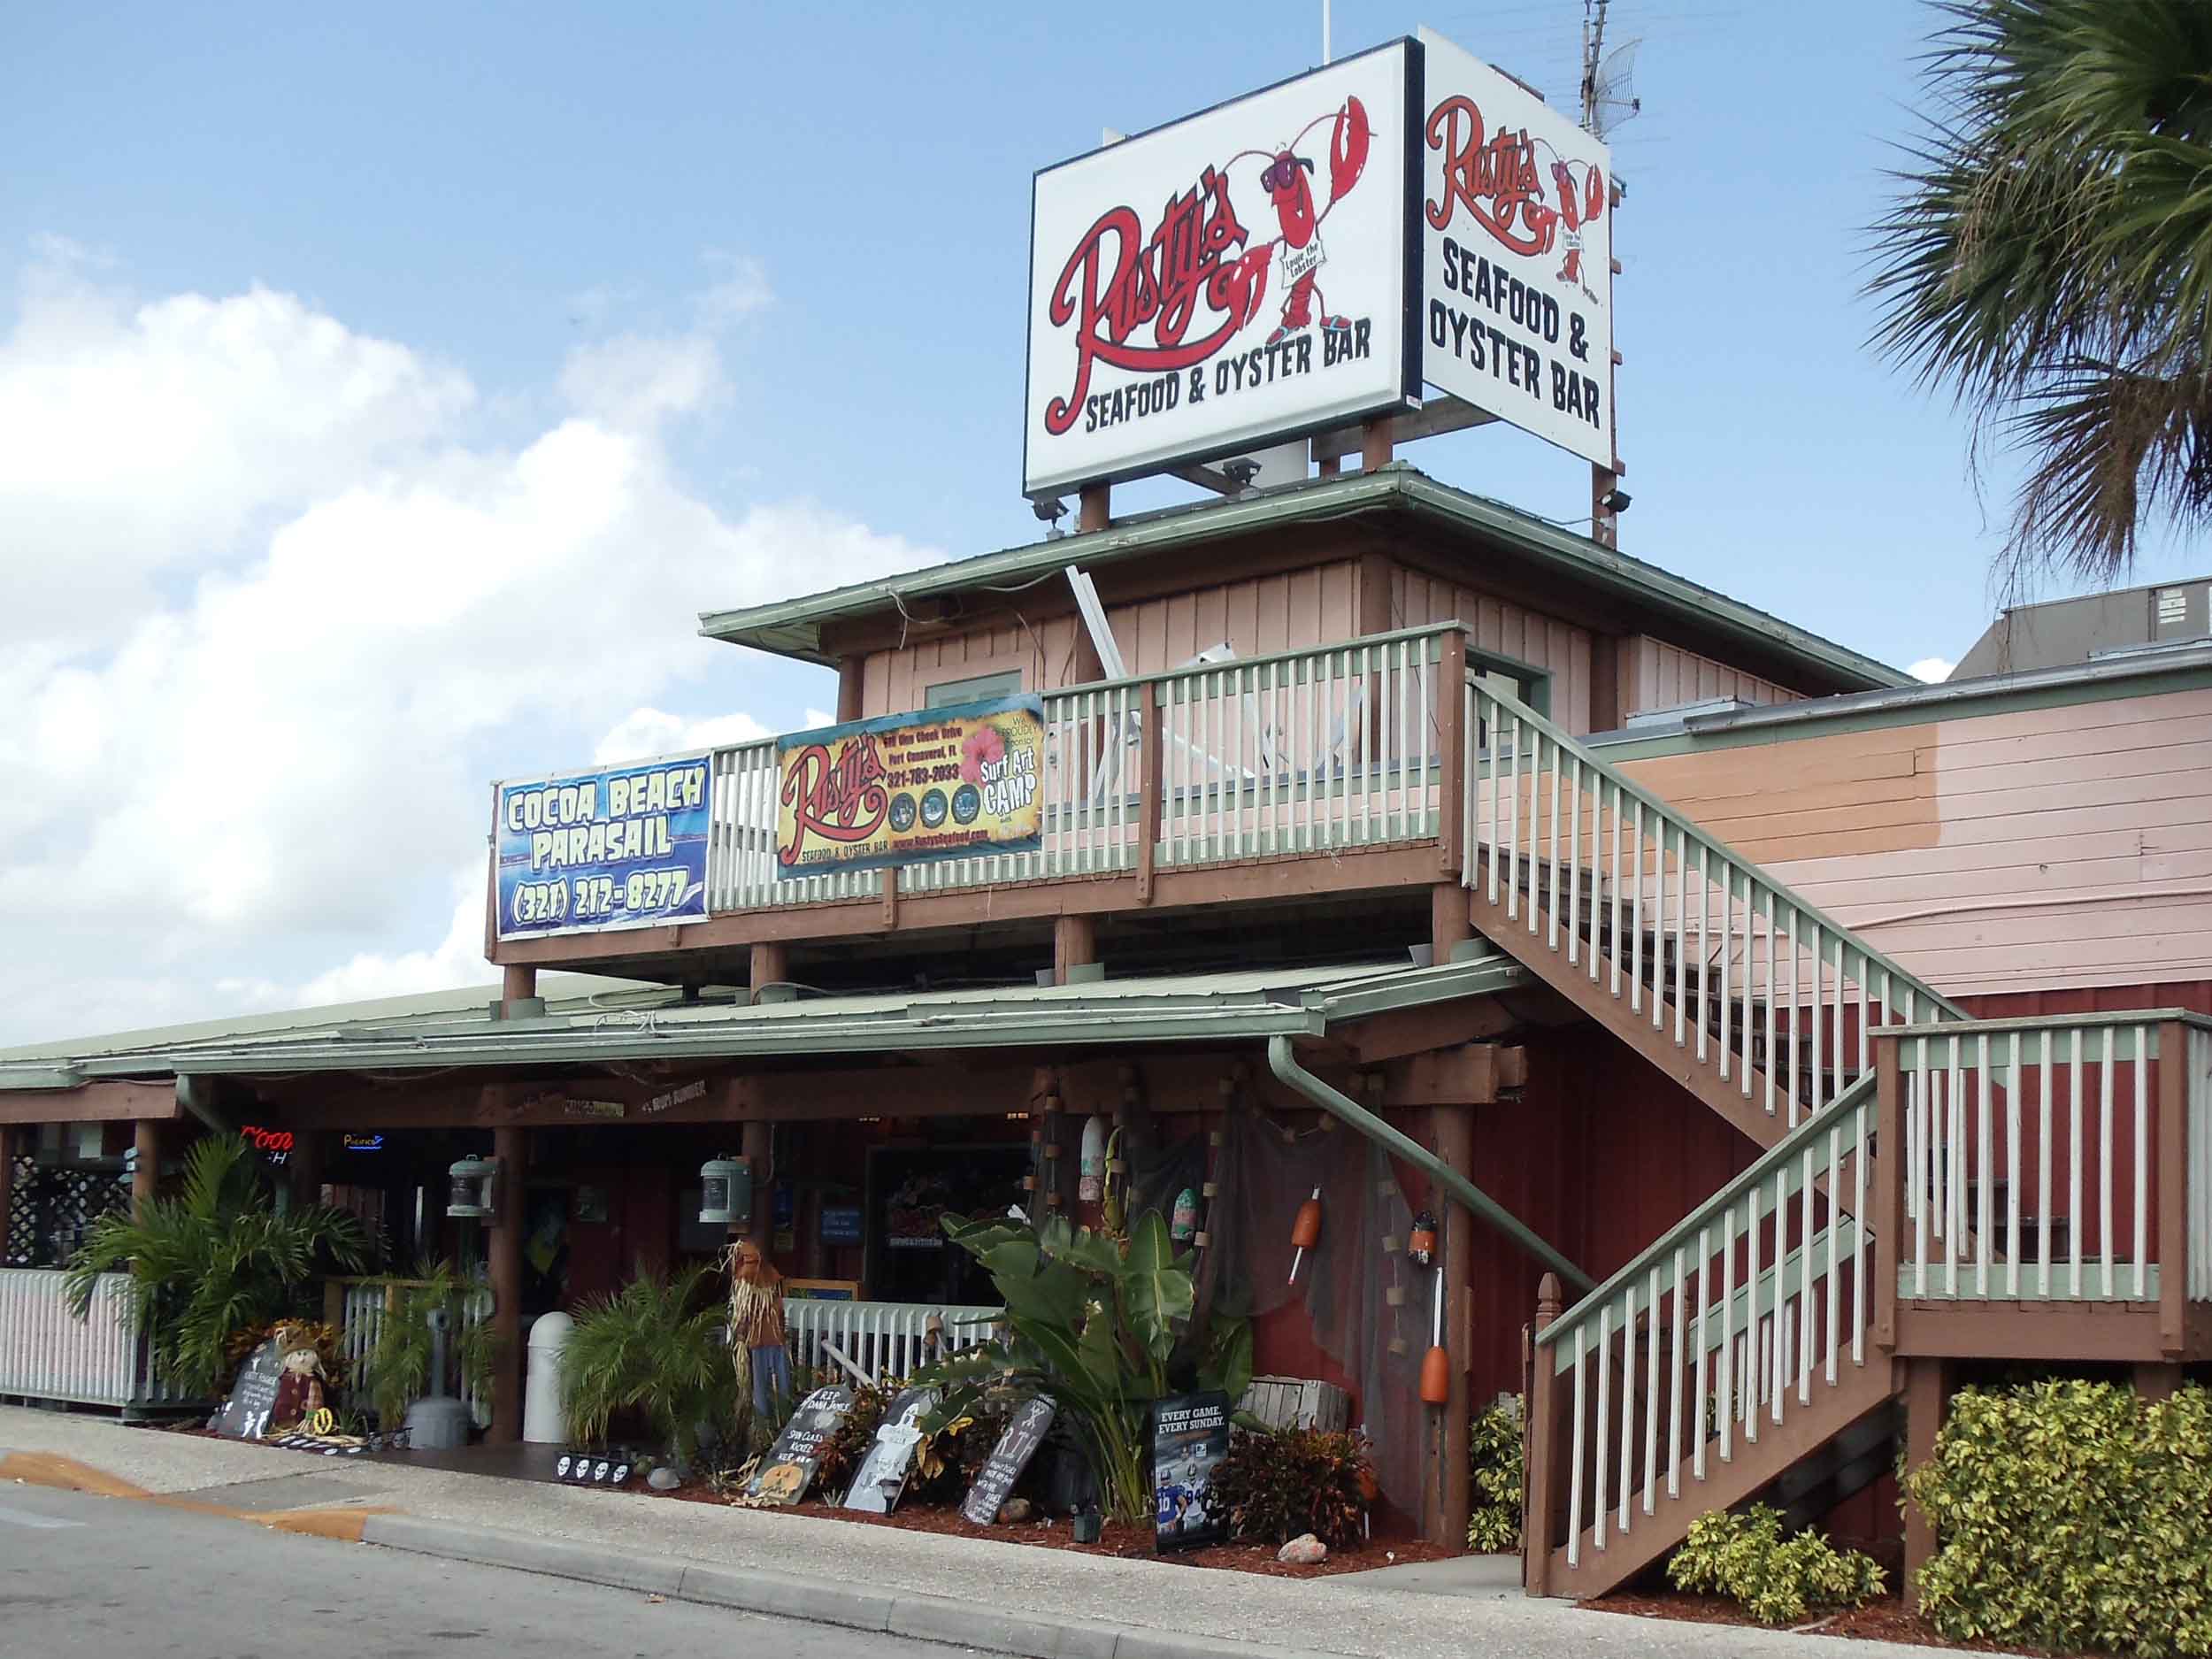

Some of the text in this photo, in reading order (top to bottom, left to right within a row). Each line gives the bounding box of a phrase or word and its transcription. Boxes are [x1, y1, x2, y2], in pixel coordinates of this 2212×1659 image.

[1425, 95, 1548, 257] Rusty's
[1045, 164, 1250, 435] Rusty's
[1442, 236, 1590, 364] SEAFOOD &
[1086, 318, 1371, 433] SEAFOOD & OYSTER BAR
[1430, 298, 1600, 430] OYSTER BAR
[979, 745, 1034, 783] Surf Art
[507, 765, 706, 833] COCOA BEACH
[779, 730, 888, 866] Rusty's
[983, 773, 1037, 816] CAMP
[532, 814, 673, 871] PARASAIL
[802, 848, 832, 863] SEAFOOD
[843, 843, 871, 857] OYSTER
[873, 840, 887, 853] BAR
[512, 869, 688, 924] (321) 212-8277
[819, 1390, 841, 1401] RIP
[1161, 1405, 1222, 1423] EVERY GAME.
[1159, 1416, 1225, 1434] EVERY SUNDAY.
